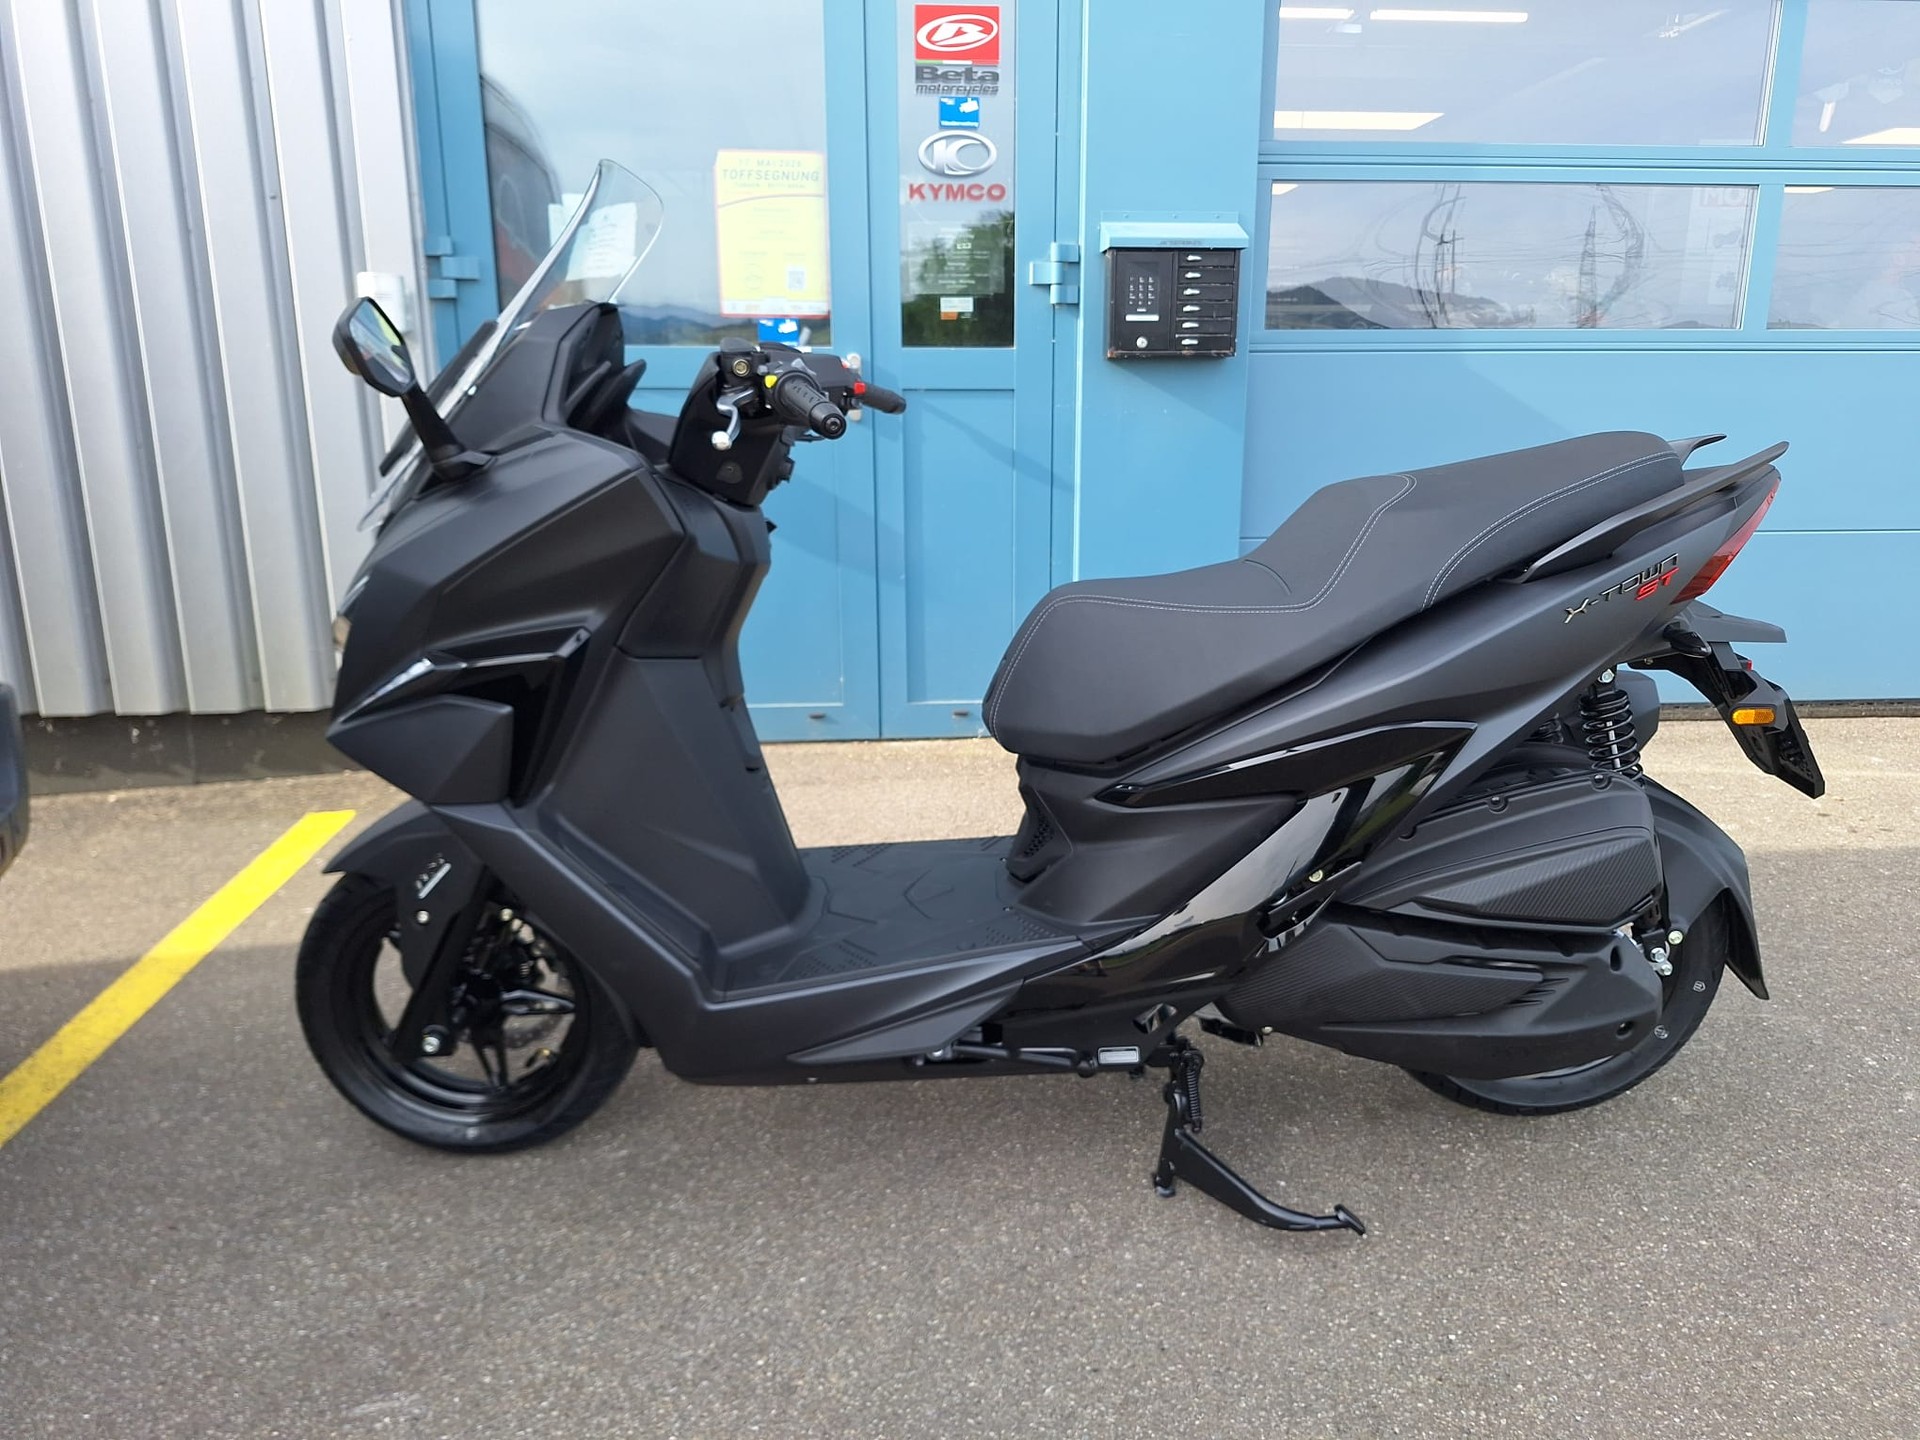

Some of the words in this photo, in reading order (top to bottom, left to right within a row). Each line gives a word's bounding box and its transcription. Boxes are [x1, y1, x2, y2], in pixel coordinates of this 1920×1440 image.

[915, 66, 999, 83] Beta
[915, 83, 999, 96] motorcycles
[909, 183, 1006, 201] KYMCO
[1564, 553, 1679, 624] X-TOWN
[1634, 567, 1680, 601] ST
